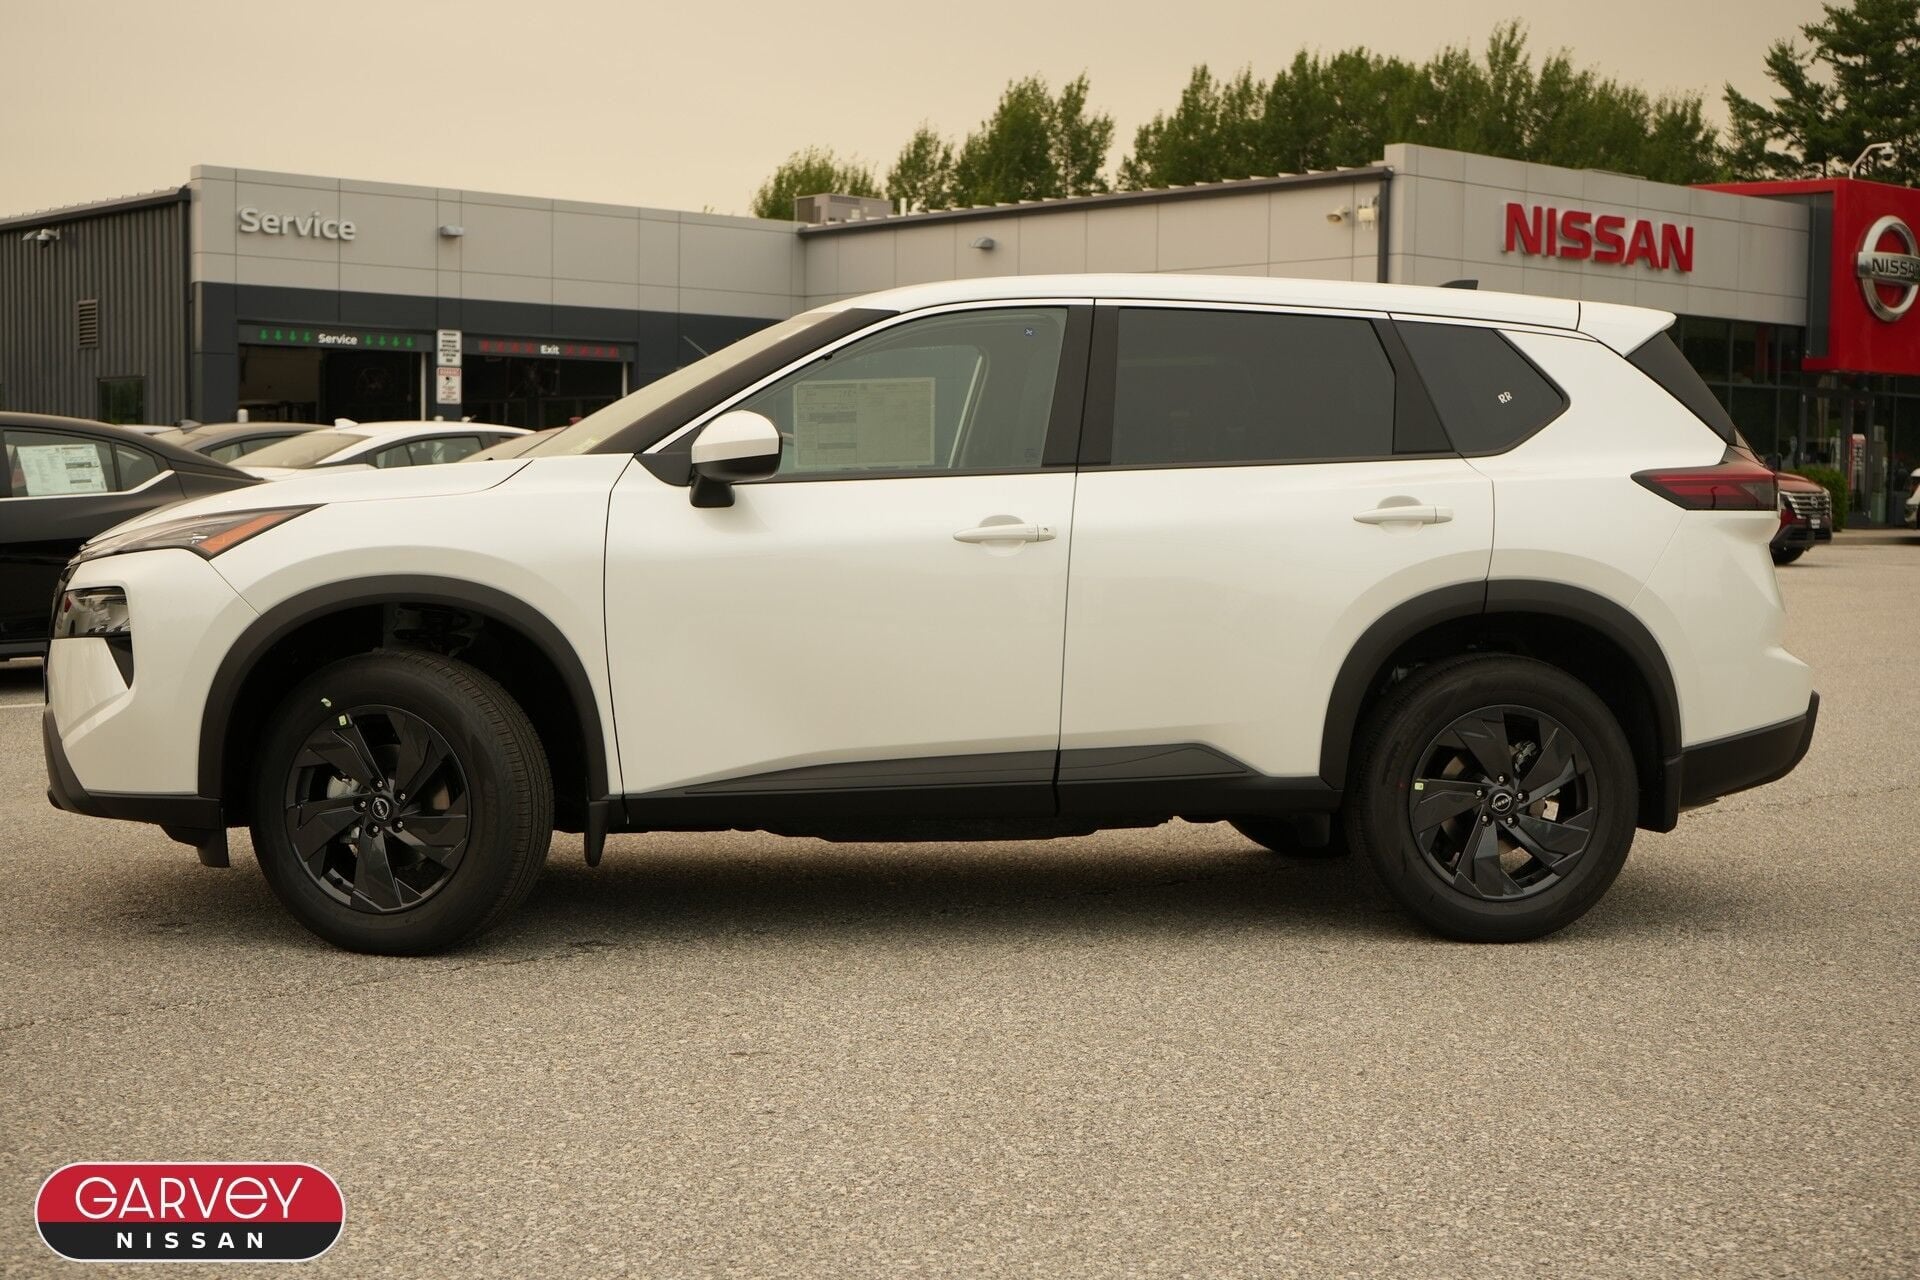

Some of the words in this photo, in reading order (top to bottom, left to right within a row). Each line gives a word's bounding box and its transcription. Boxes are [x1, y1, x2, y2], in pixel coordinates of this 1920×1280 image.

[240, 207, 356, 240] Service
[1505, 202, 1694, 272] NISSAN
[318, 333, 358, 345] Service
[540, 344, 560, 355] Exit
